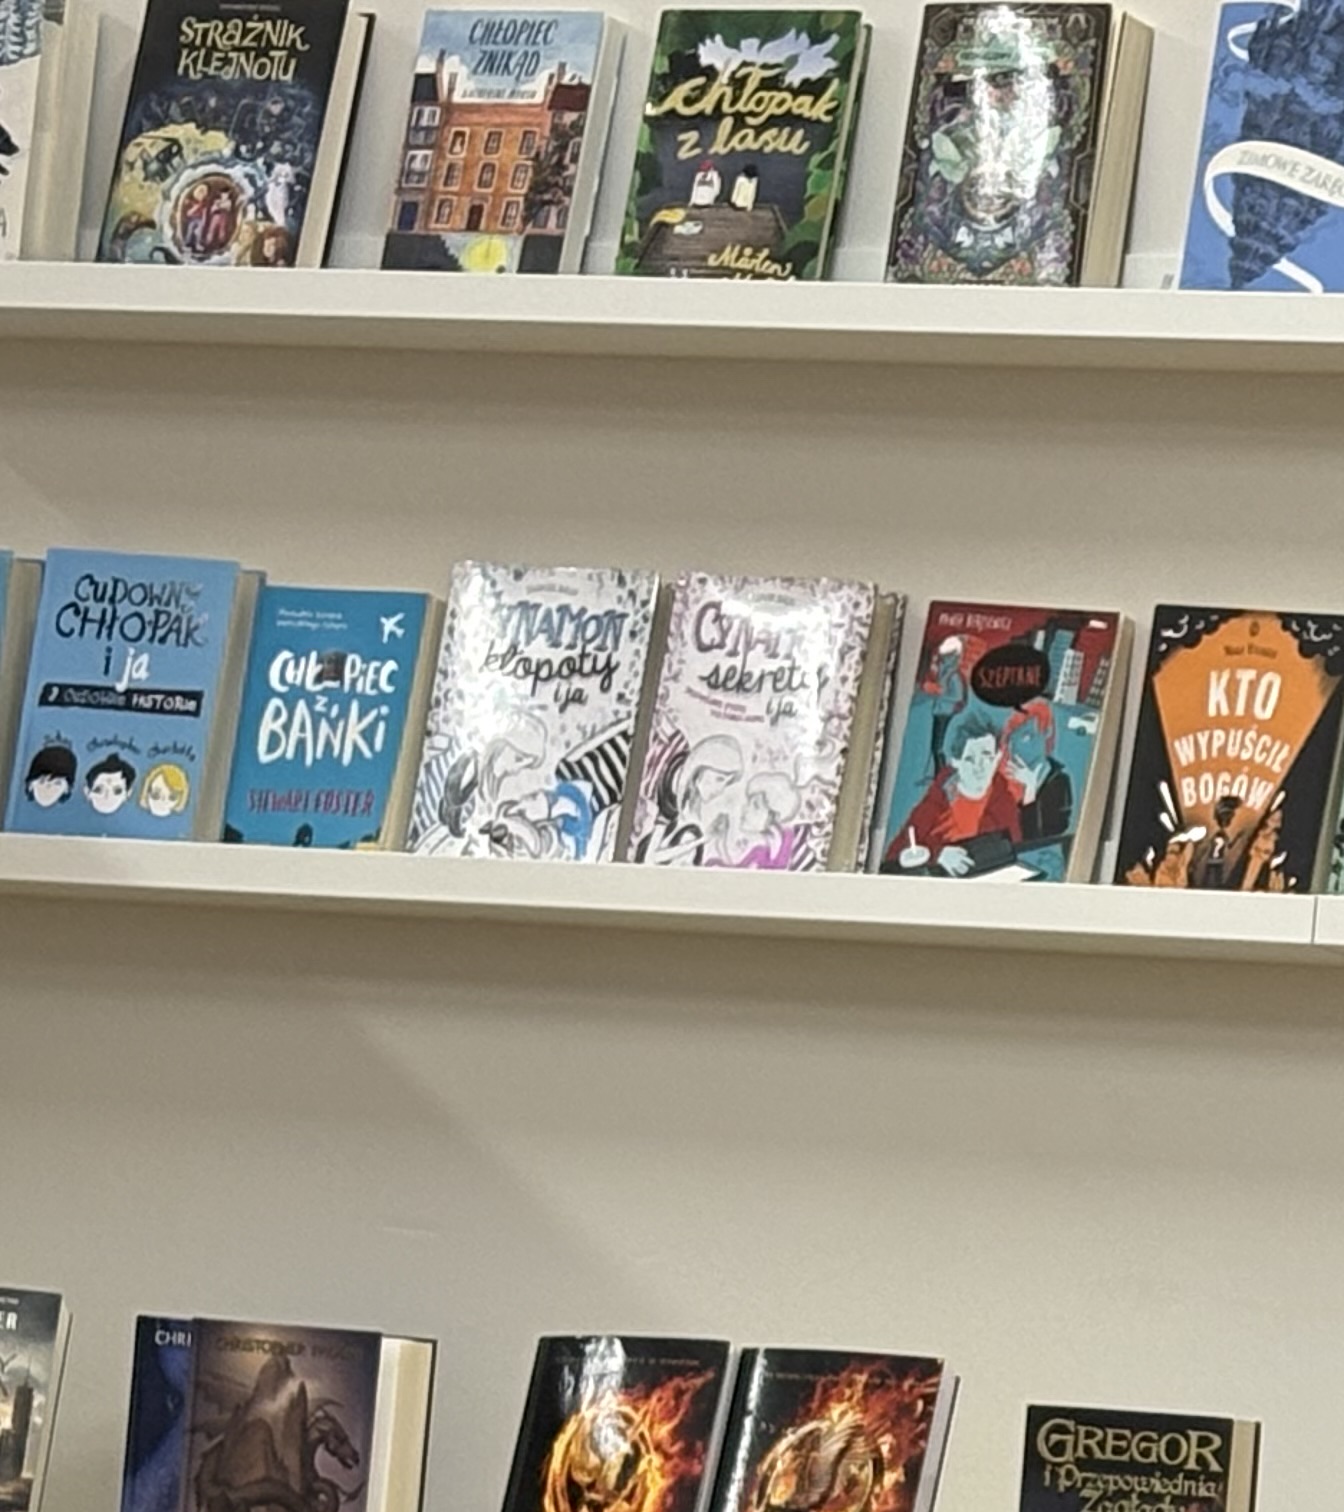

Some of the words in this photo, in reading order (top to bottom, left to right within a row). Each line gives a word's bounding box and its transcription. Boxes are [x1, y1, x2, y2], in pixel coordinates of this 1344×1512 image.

[179, 14, 310, 51] STRAŻNIK
[468, 17, 559, 46] CHŁOPIEC
[178, 46, 297, 82] KLEJNOTU
[470, 47, 542, 79] ZNIKĄD
[676, 131, 702, 161] z
[707, 114, 812, 157] lasu
[494, 600, 630, 652] YNAMON
[103, 645, 113, 677] i
[115, 647, 151, 692] ja
[1207, 667, 1282, 720] KTO
[257, 697, 390, 768] BAŃKI
[1173, 723, 1291, 773] WYPUŚCIŁ
[1181, 766, 1275, 811] BOGÓW
[1035, 1417, 1223, 1472] GREGOR
[1055, 1463, 1222, 1500] Przepowiednia
